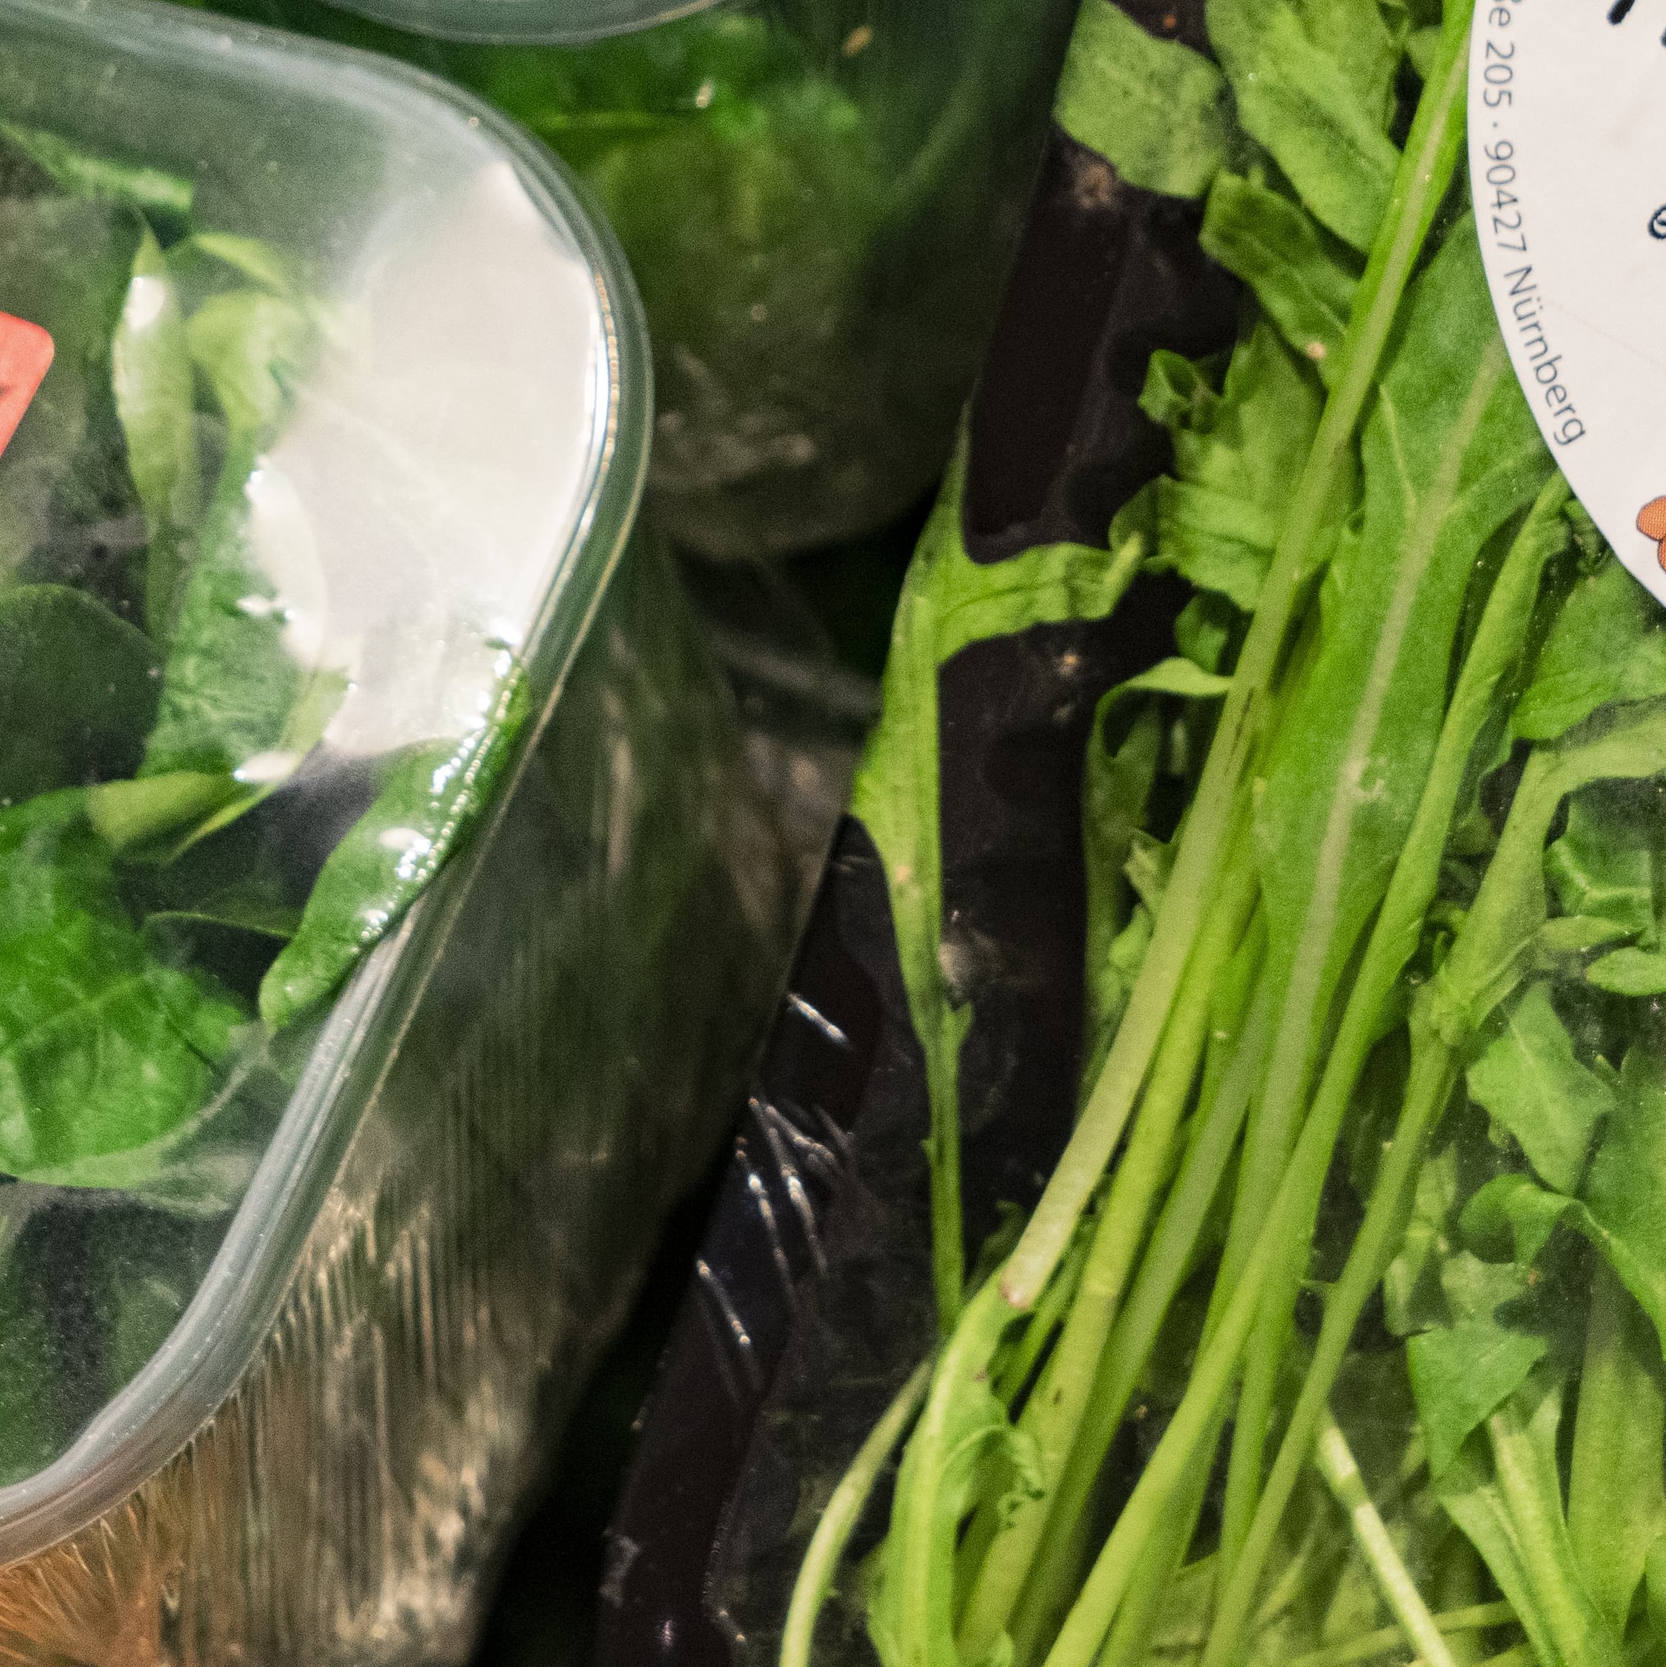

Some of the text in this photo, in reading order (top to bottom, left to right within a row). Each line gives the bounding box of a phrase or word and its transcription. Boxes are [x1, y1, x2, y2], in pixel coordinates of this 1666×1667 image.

[1483, 41, 1514, 107] 205
[1484, 140, 1527, 254] 90427
[1504, 265, 1586, 446] Nürnberg
